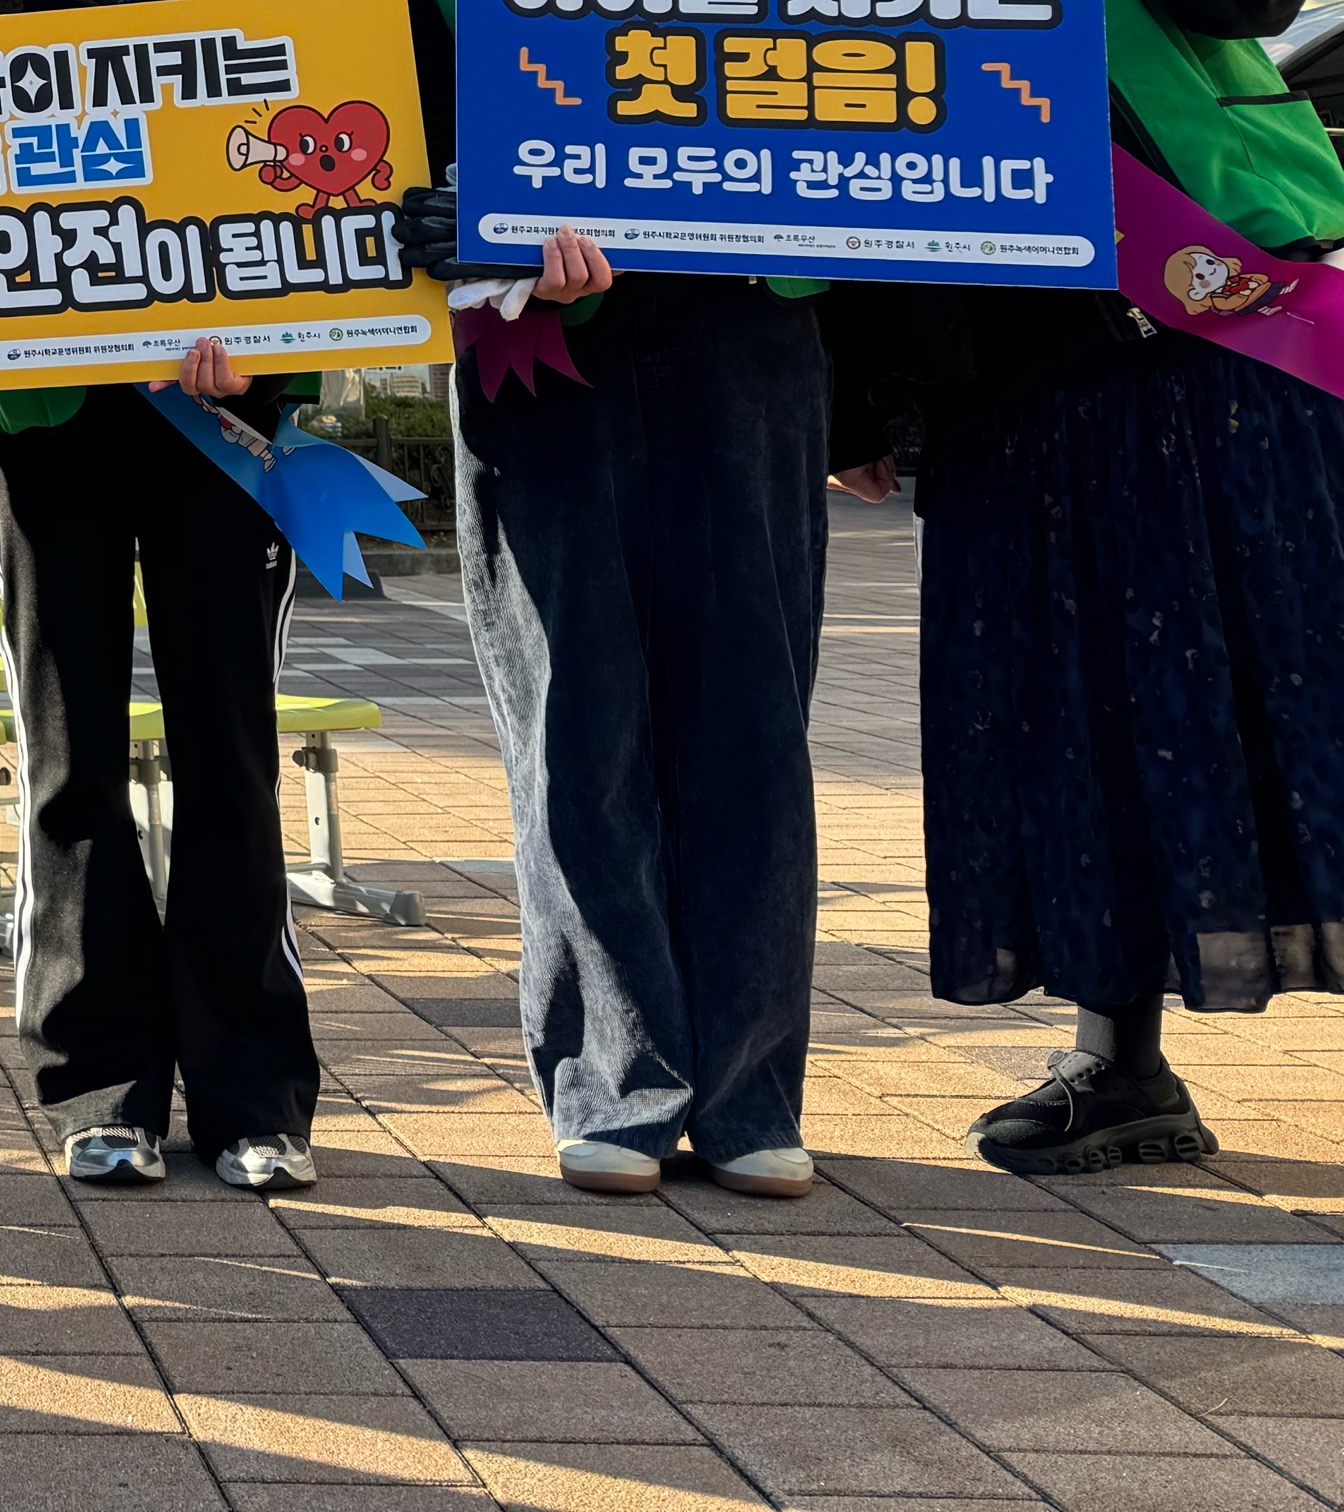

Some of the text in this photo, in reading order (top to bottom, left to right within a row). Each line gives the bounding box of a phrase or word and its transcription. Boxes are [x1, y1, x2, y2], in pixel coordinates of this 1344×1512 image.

[86, 36, 292, 108] 지키는
[615, 28, 937, 126] 첫 걸음!
[12, 112, 143, 185] 관심
[512, 139, 1054, 205] 우리 모두의 관심입니다
[219, 210, 403, 291] 됩니다
[863, 239, 915, 250] 원주경찰서
[945, 242, 971, 253] 원주시
